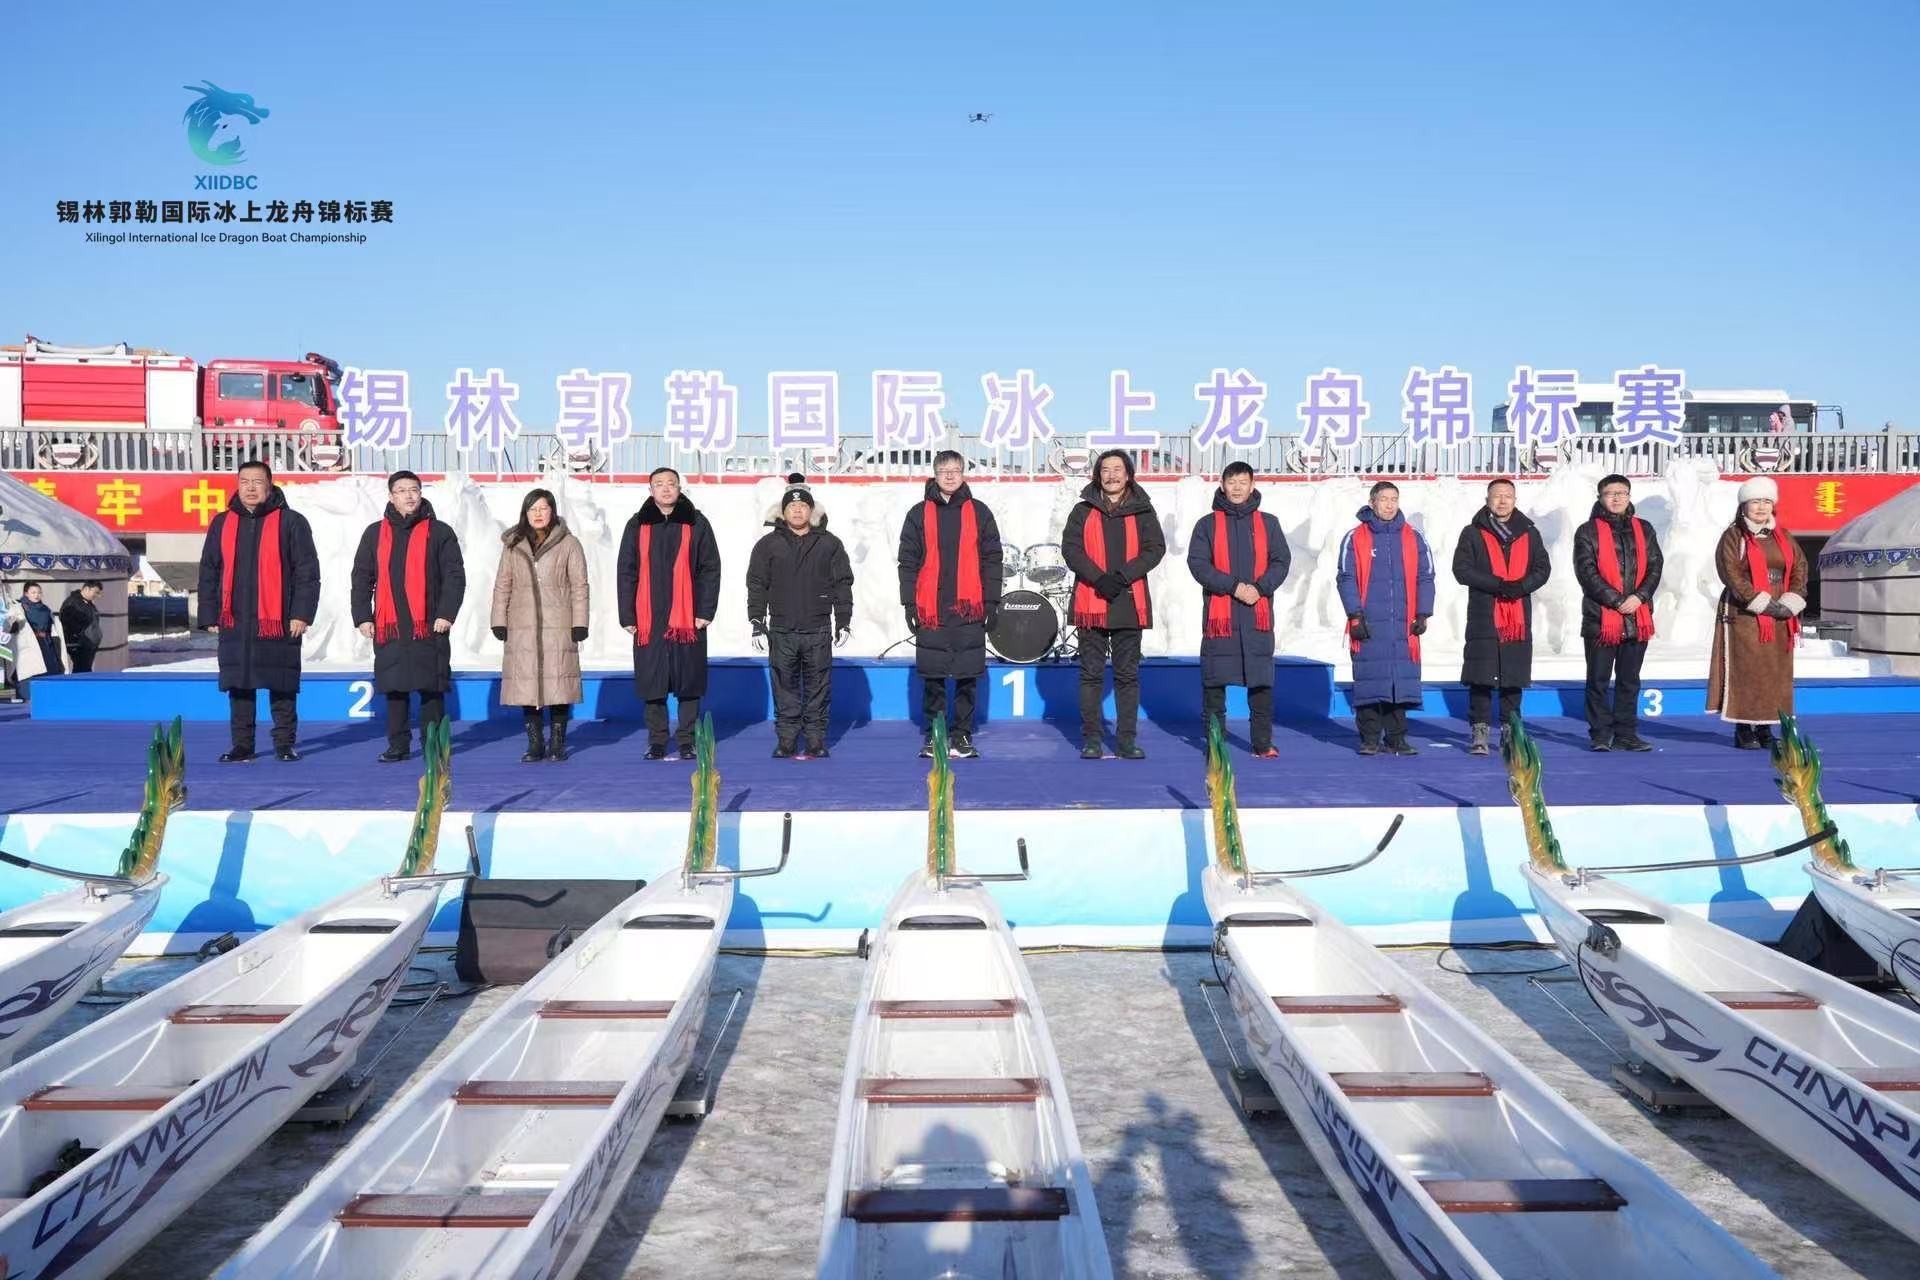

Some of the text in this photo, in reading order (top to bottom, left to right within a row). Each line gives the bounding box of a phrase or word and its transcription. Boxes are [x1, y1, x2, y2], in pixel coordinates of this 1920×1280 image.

[338, 366, 1686, 449] 锡林郭勒国际冰上龙舟锦标赛
[349, 681, 373, 718] 2
[1003, 670, 1025, 716] 1
[1643, 689, 1663, 717] 3
